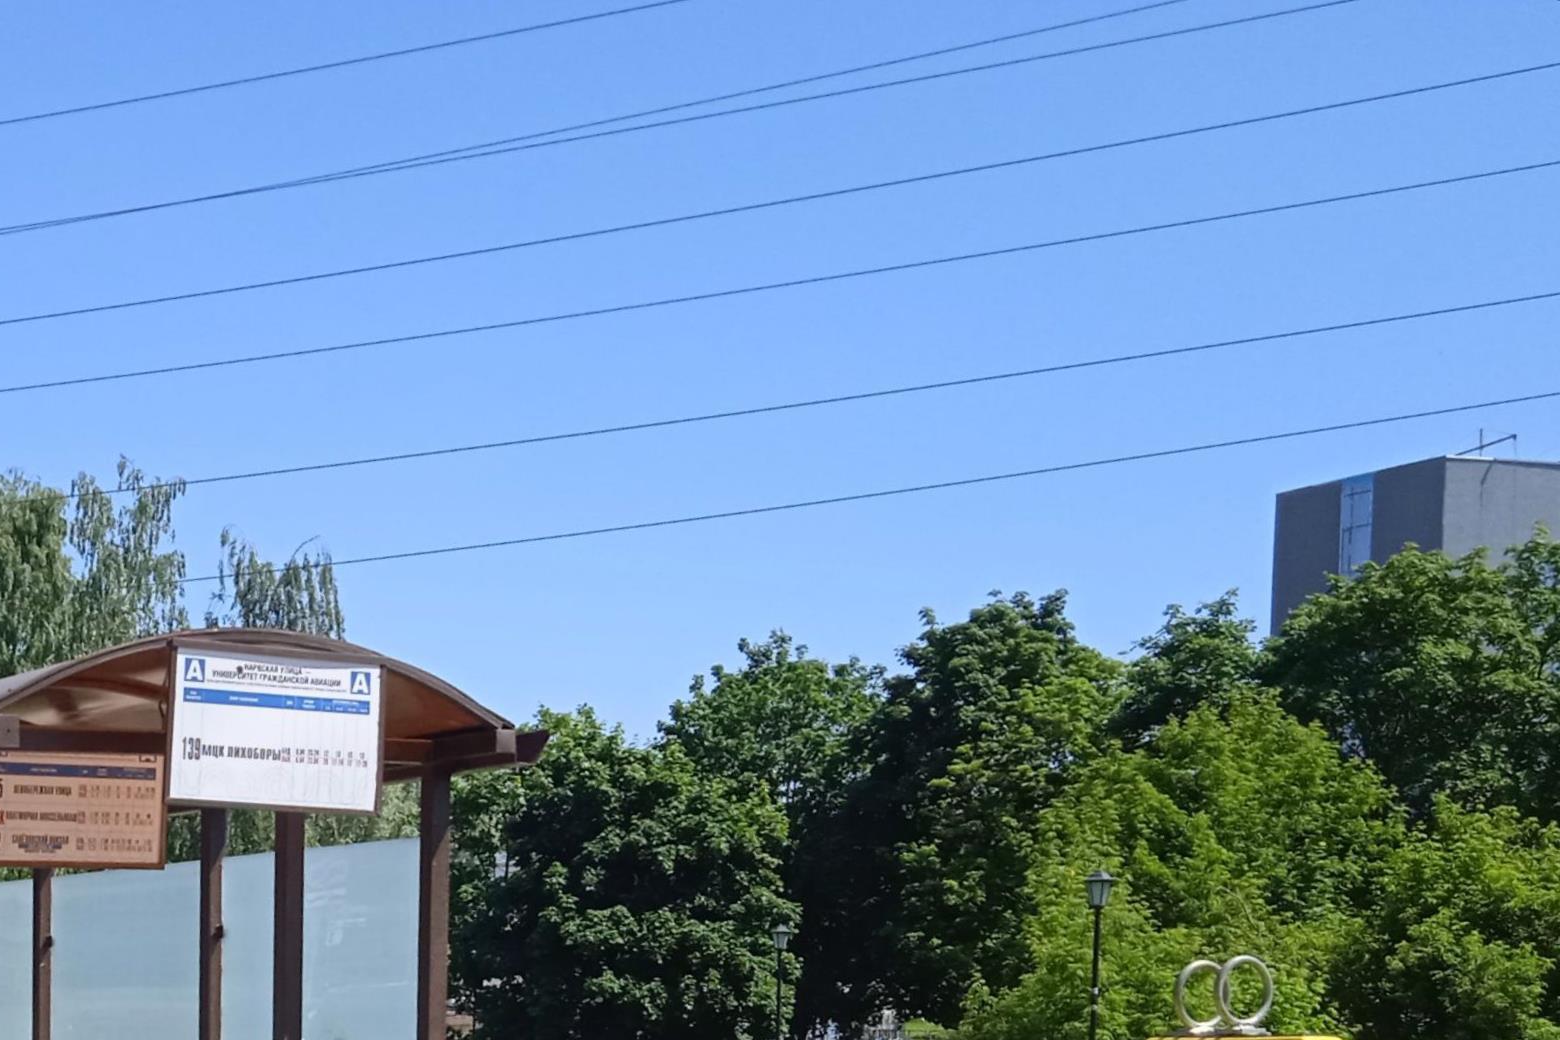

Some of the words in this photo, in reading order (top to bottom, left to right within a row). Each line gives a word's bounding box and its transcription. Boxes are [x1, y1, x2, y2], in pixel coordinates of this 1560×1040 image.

[211, 670, 258, 681] УНИВЕРСИТЕТ
[259, 673, 309, 684] ГРАЖДАНСКОЙ
[310, 676, 342, 687] АВИАЦИИ
[182, 736, 201, 760] 139
[202, 744, 225, 757] МЦК
[227, 746, 281, 761] ЛИХОБОРЫ
